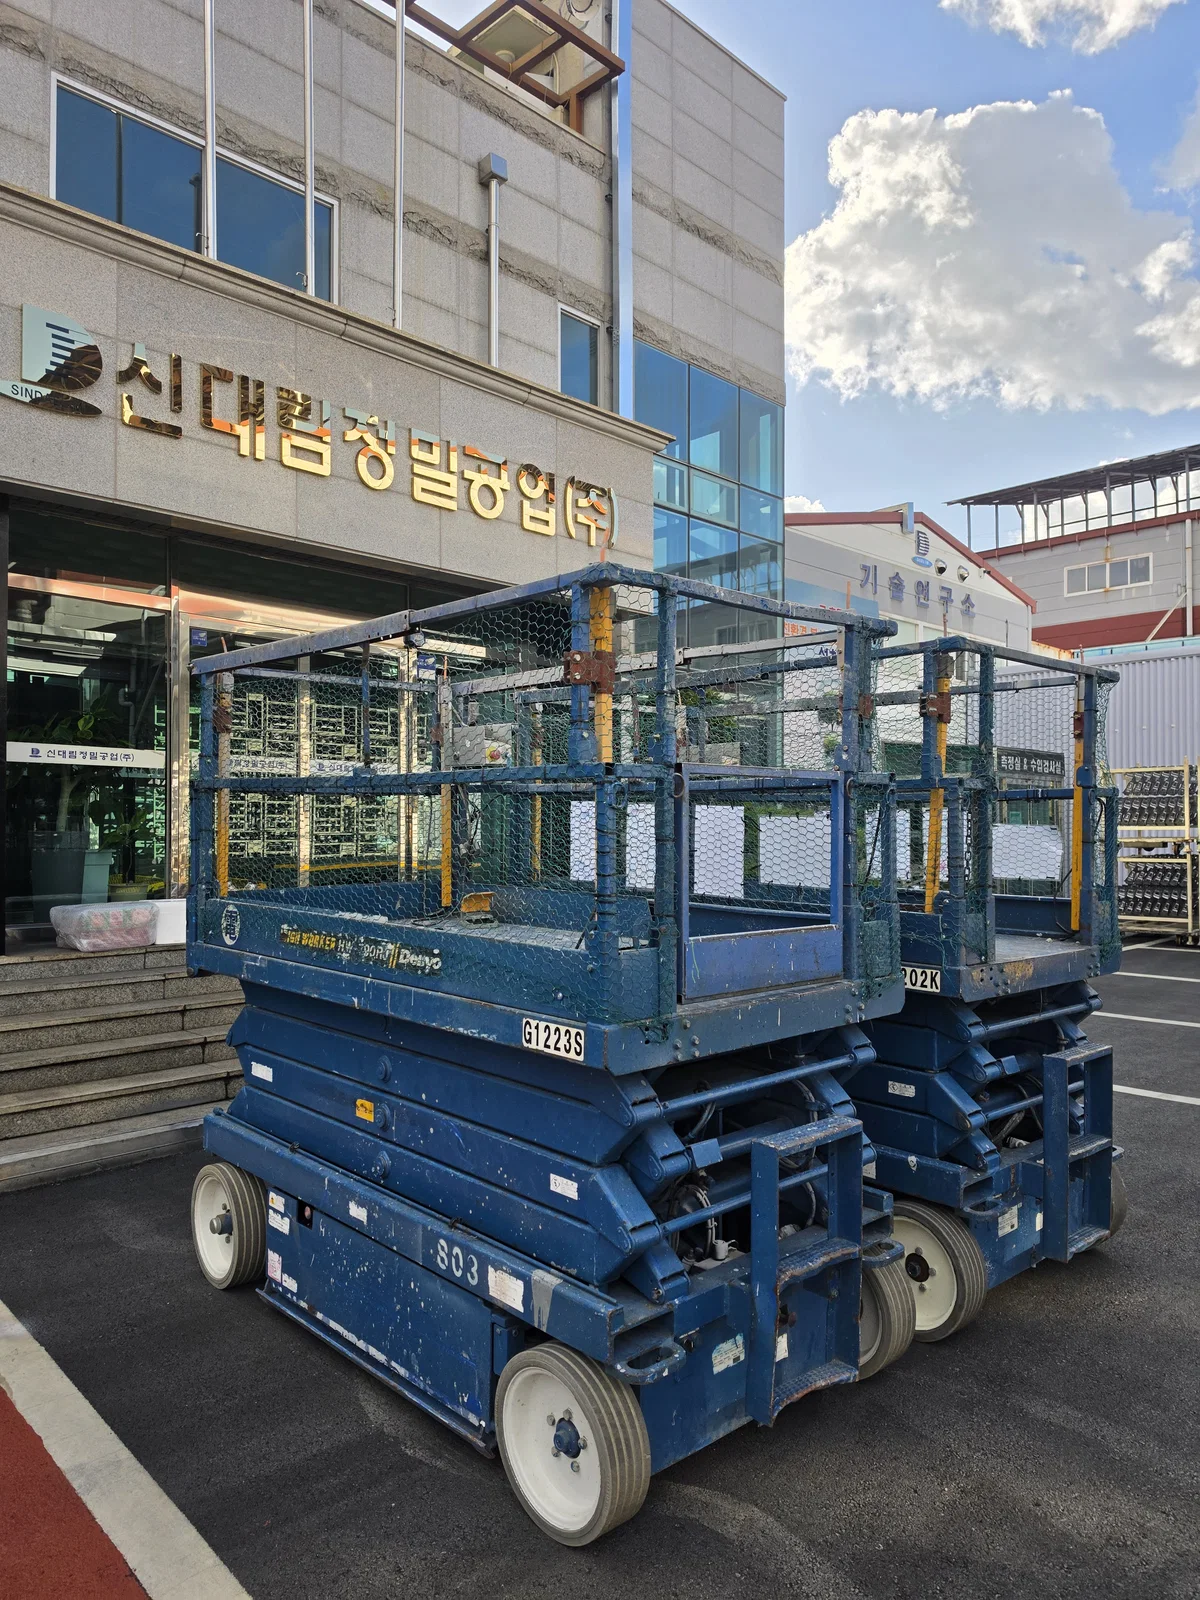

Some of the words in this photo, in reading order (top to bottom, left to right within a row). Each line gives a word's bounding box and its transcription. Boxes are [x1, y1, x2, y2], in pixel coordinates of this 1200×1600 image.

[116, 342, 619, 549] 신대림정밀공업(주)
[859, 563, 976, 618] 기술연구소
[46, 748, 135, 762] 신대림정밀공업(주)
[1001, 755, 1021, 770] 측정실
[1030, 758, 1062, 774] 수입검사실
[523, 1019, 583, 1057] G1223S
[437, 1238, 478, 1286] 803
